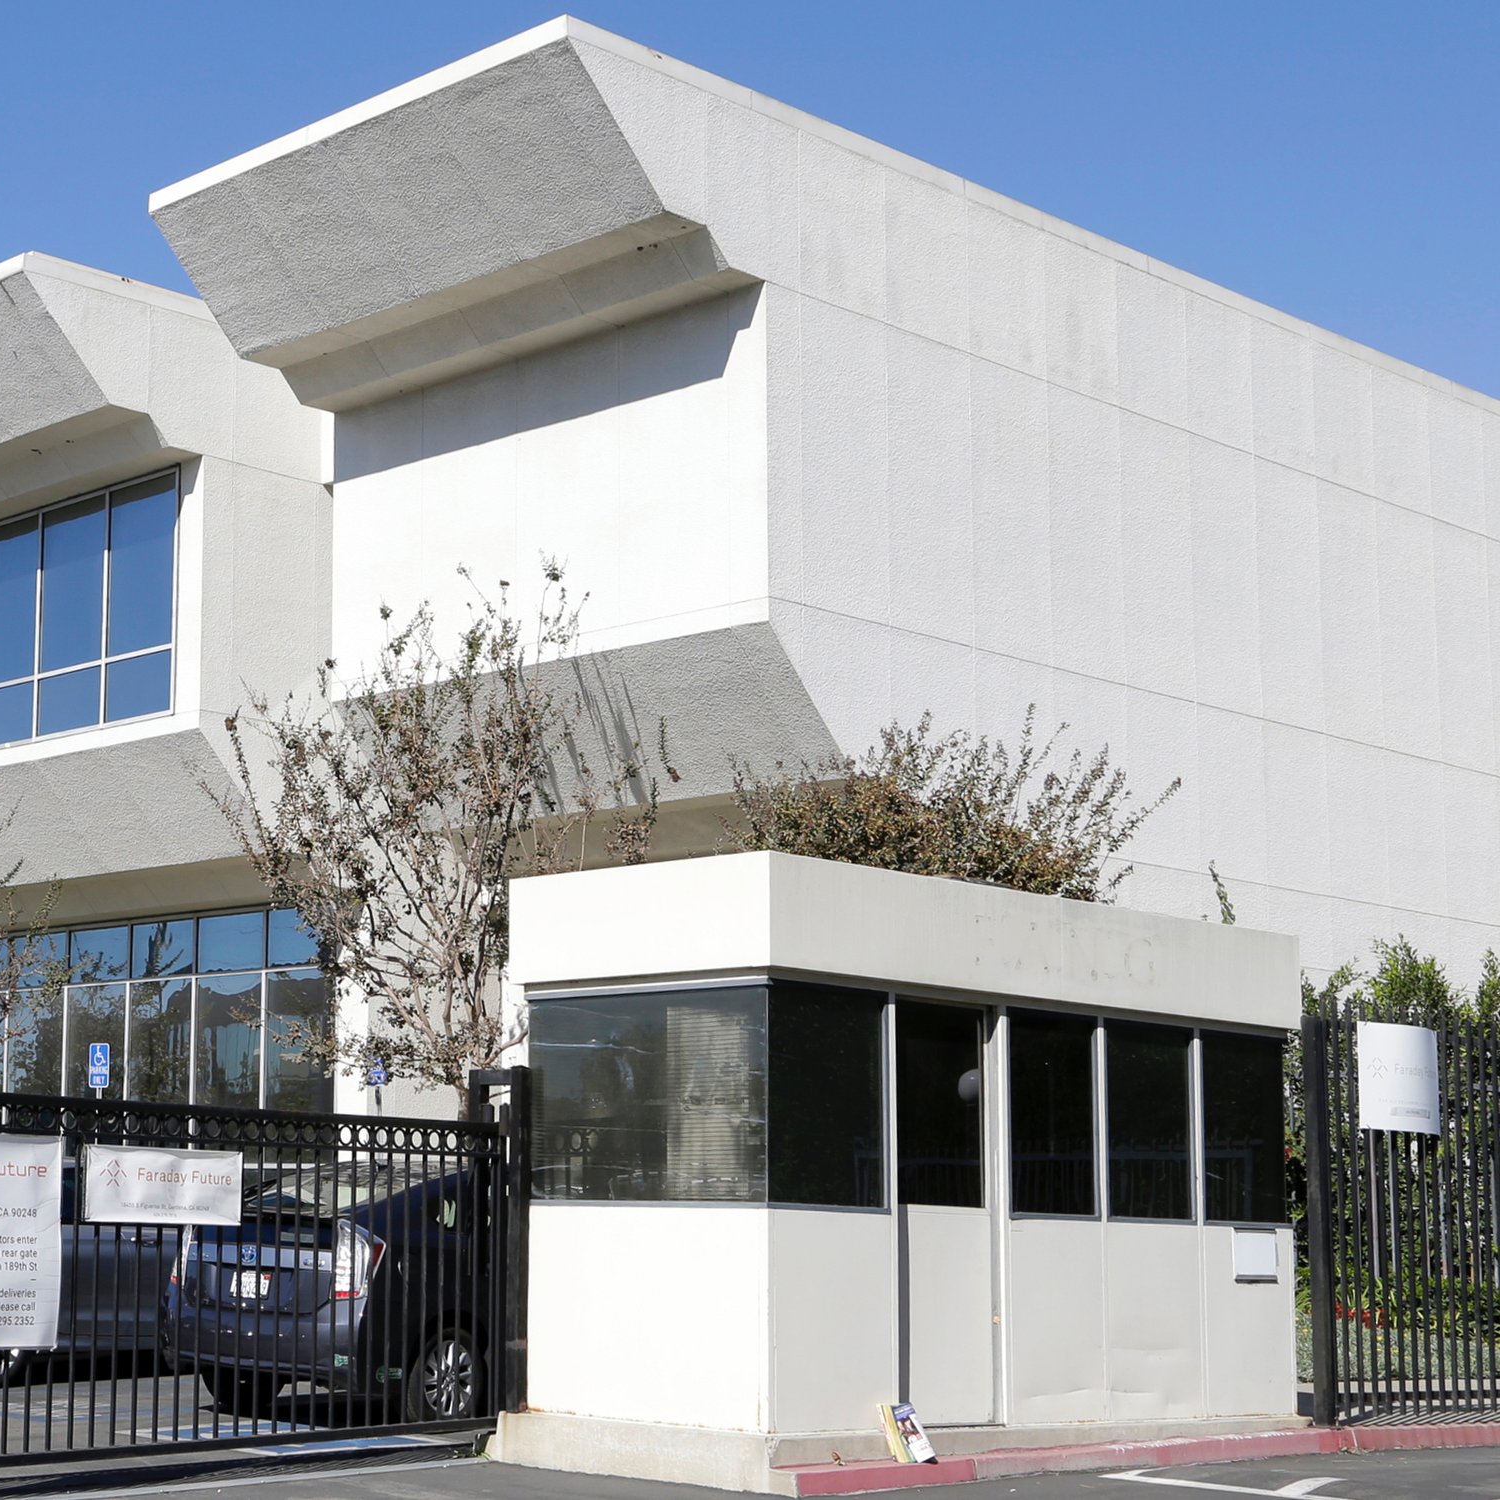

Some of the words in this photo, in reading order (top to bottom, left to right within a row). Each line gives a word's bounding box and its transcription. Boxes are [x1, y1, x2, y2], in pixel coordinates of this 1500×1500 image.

[137, 1167, 187, 1187] Faraday
[191, 1170, 232, 1186] Future
[12, 1208, 37, 1218] 90248
[17, 1236, 38, 1244] enter
[2, 1249, 17, 1257] rear
[20, 1249, 38, 1259] gate
[4, 1262, 27, 1271] 189th
[29, 1261, 38, 1271] St
[21, 1302, 36, 1311] call
